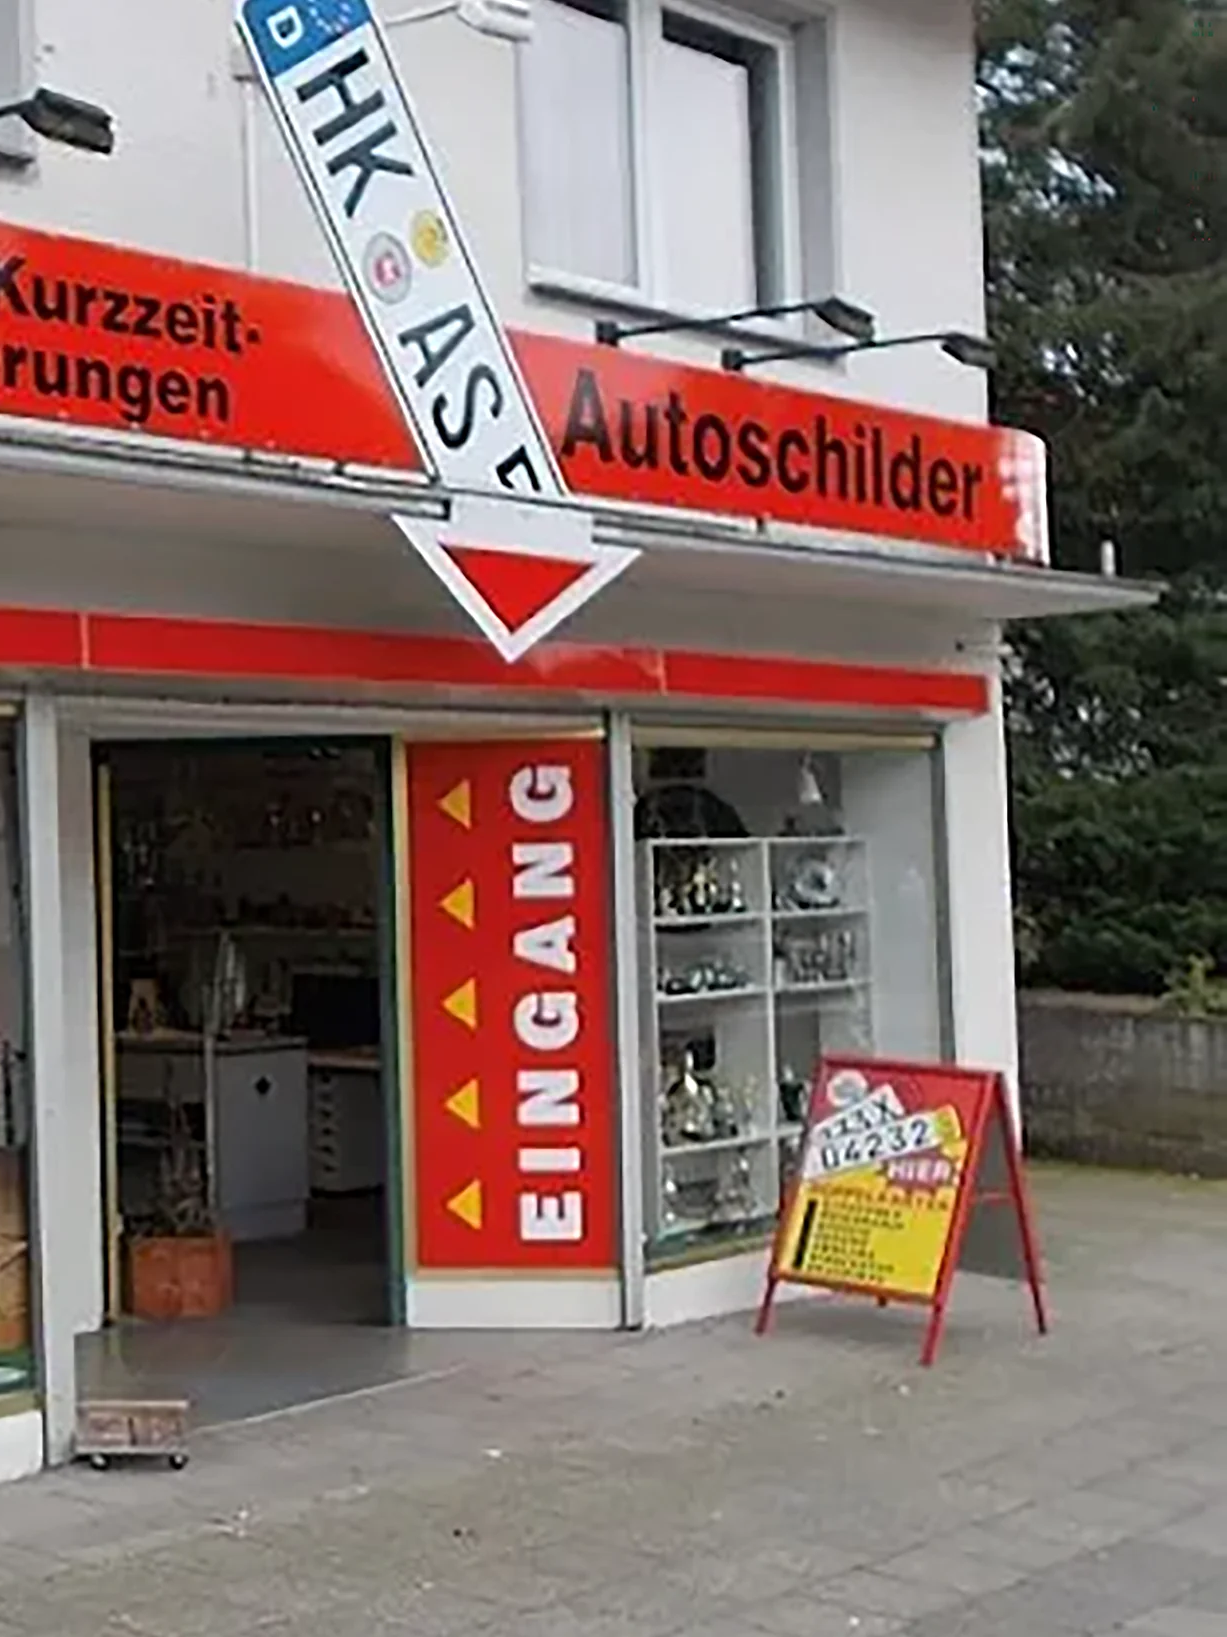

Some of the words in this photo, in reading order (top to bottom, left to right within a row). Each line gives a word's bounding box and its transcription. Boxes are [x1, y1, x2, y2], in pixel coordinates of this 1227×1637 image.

[266, 6, 303, 48] D
[296, 47, 414, 218] HK
[398, 304, 503, 448] AS
[561, 368, 982, 521] Autoschilder
[509, 764, 582, 1240] EINGANG
